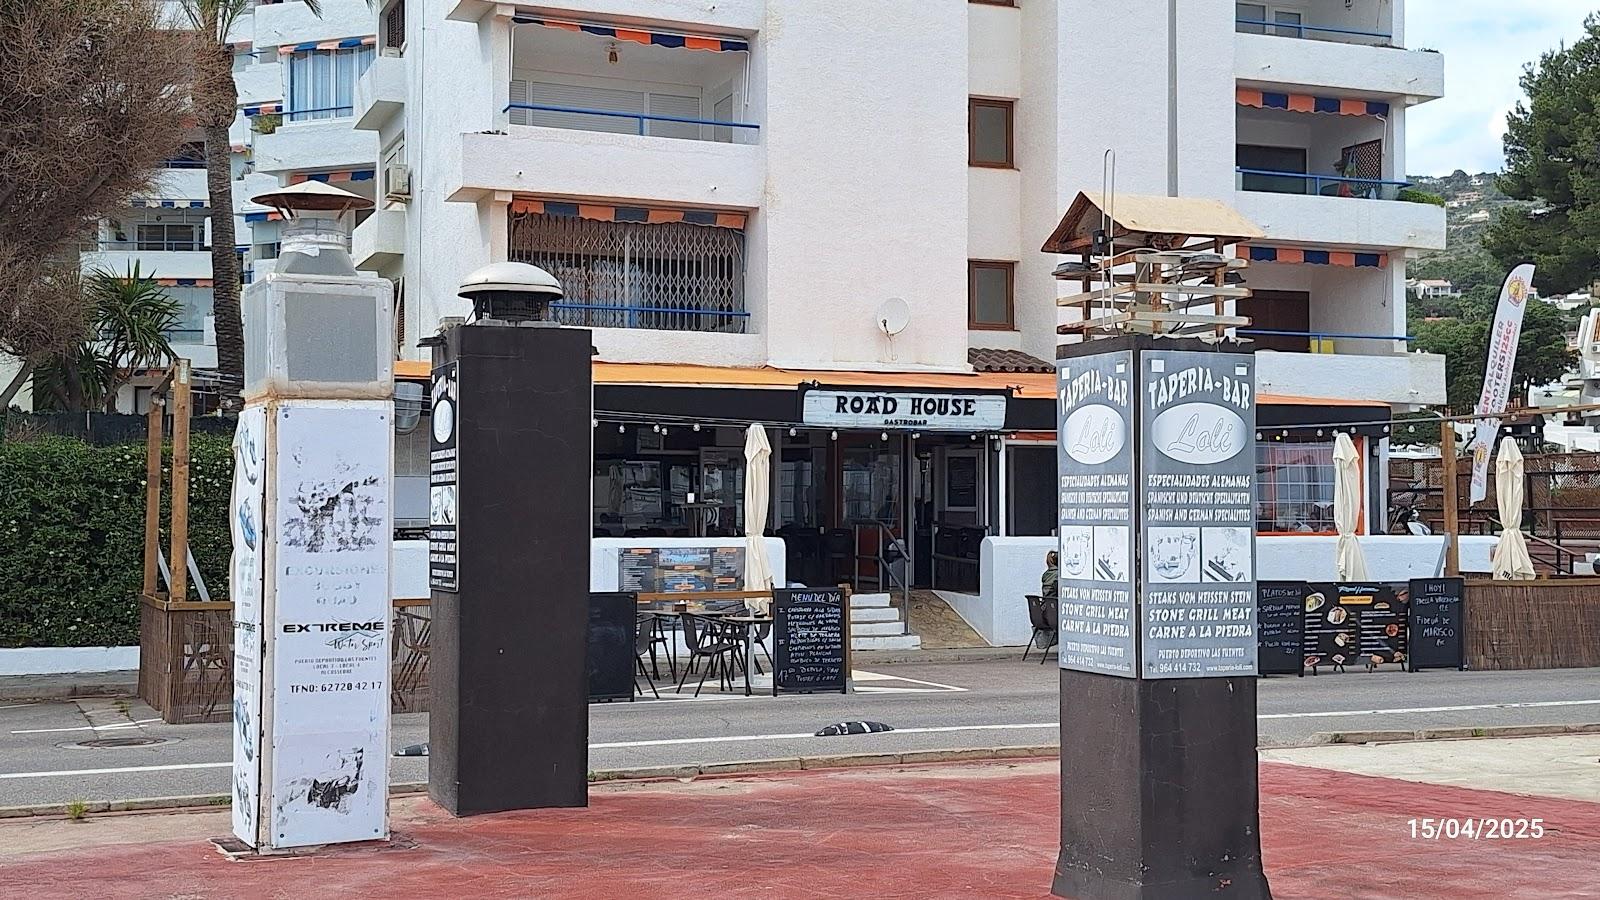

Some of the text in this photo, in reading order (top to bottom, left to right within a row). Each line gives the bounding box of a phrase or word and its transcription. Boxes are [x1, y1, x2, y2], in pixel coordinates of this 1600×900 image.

[1060, 368, 1128, 415] TAPERIA-BAR
[1149, 366, 1250, 411] TAPERIA-BAR
[835, 395, 976, 416] ROAD HOUSE
[884, 418, 928, 426] GASTROBAR
[1072, 415, 1116, 454] Loli
[1167, 412, 1233, 453] Loli
[1148, 474, 1250, 488] ESPECIALIDADES ALEMANAS
[1176, 491, 1188, 504] UND
[1148, 508, 1173, 521] SPANISH
[1174, 508, 1188, 521] AND
[1189, 508, 1214, 521] GERMAN
[791, 592, 840, 601] MENU DEL DÍA
[1061, 587, 1079, 599] STEAKS
[1080, 588, 1091, 600] VOM
[1149, 590, 1252, 604] STEAKS VOM HEISSEN STEIN
[1061, 603, 1129, 620] STONE GRILL MEAT
[1149, 609, 1185, 622] STONE
[1189, 608, 1218, 621] GRILL
[1223, 607, 1252, 620] MEAT
[283, 622, 384, 633] EXTREME
[1061, 619, 1130, 638] CARNE A LA PIEDRA
[1149, 626, 1186, 639] CARNE
[1188, 626, 1196, 638] A
[1200, 625, 1212, 638] LA
[1215, 624, 1252, 637] PIEDRA
[1159, 647, 1245, 659] PUERTO DEPORTIVO LAS FUENTES
[1159, 663, 1172, 673] 964
[1173, 662, 1187, 672] 414
[1188, 662, 1201, 672] 732
[291, 684, 318, 693] TFNO:
[355, 682, 368, 690] 42
[372, 681, 382, 689] 17
